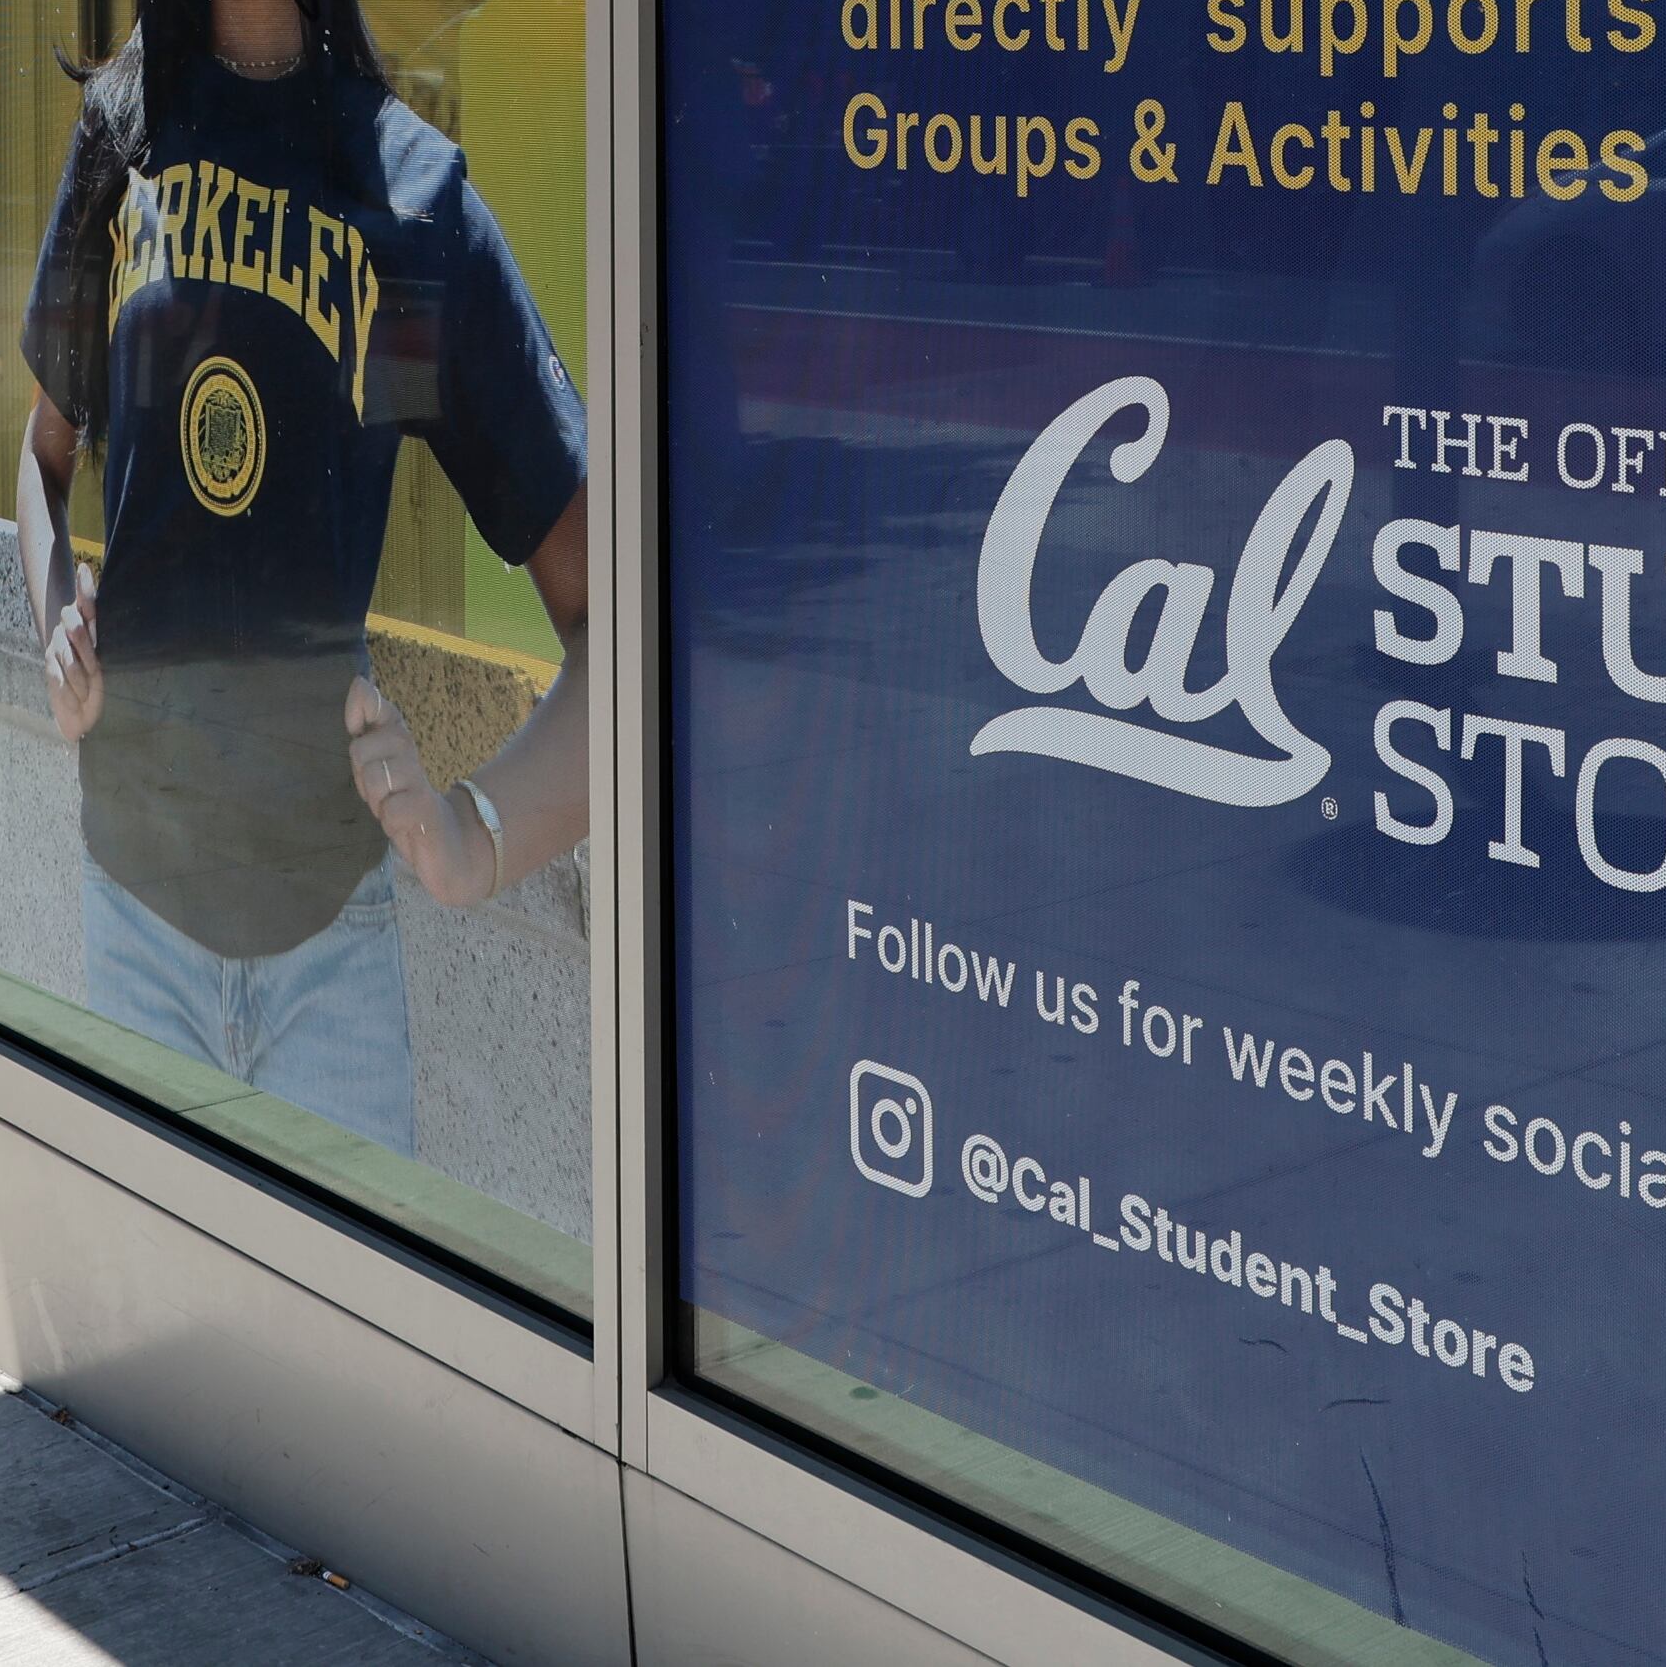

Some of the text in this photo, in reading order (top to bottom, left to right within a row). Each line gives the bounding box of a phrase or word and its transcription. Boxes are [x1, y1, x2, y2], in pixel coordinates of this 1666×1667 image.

[841, 92, 1648, 202] Groups & Activities
[1381, 406, 1531, 483] THE
[968, 374, 1355, 809] Cal
[843, 897, 1018, 1009] Follow
[1032, 969, 1102, 1037] us
[1116, 977, 1205, 1066] for
[1221, 1025, 1460, 1161] weekly
[958, 1131, 1538, 1396] @Cal_Student_Store
